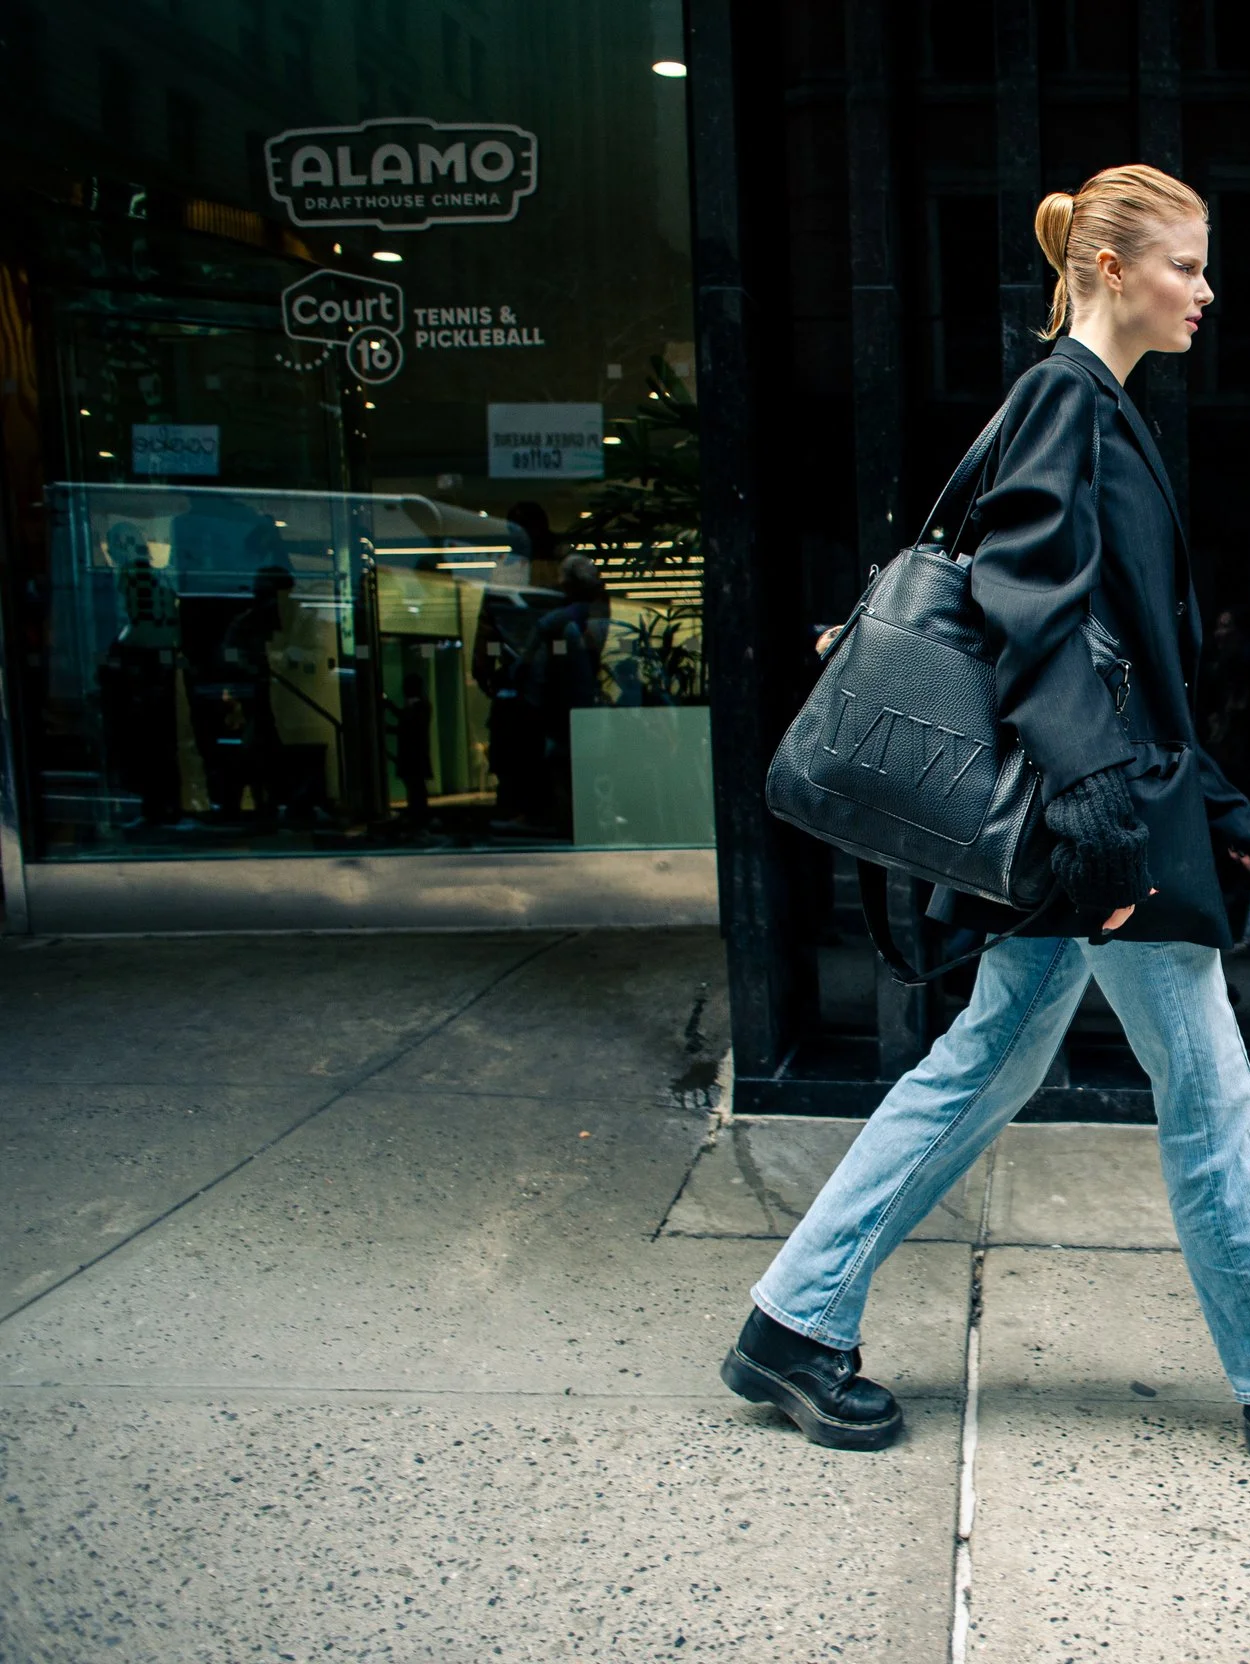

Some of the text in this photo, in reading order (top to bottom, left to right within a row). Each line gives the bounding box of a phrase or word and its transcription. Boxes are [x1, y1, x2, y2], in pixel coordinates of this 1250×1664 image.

[290, 140, 515, 187] ALAMO
[304, 192, 501, 210] DRAFTHOUSE CINEMA
[292, 292, 394, 324] Court
[414, 305, 517, 327] TENNIS &
[415, 327, 545, 349] PICKLEBALL
[356, 338, 393, 370] 16
